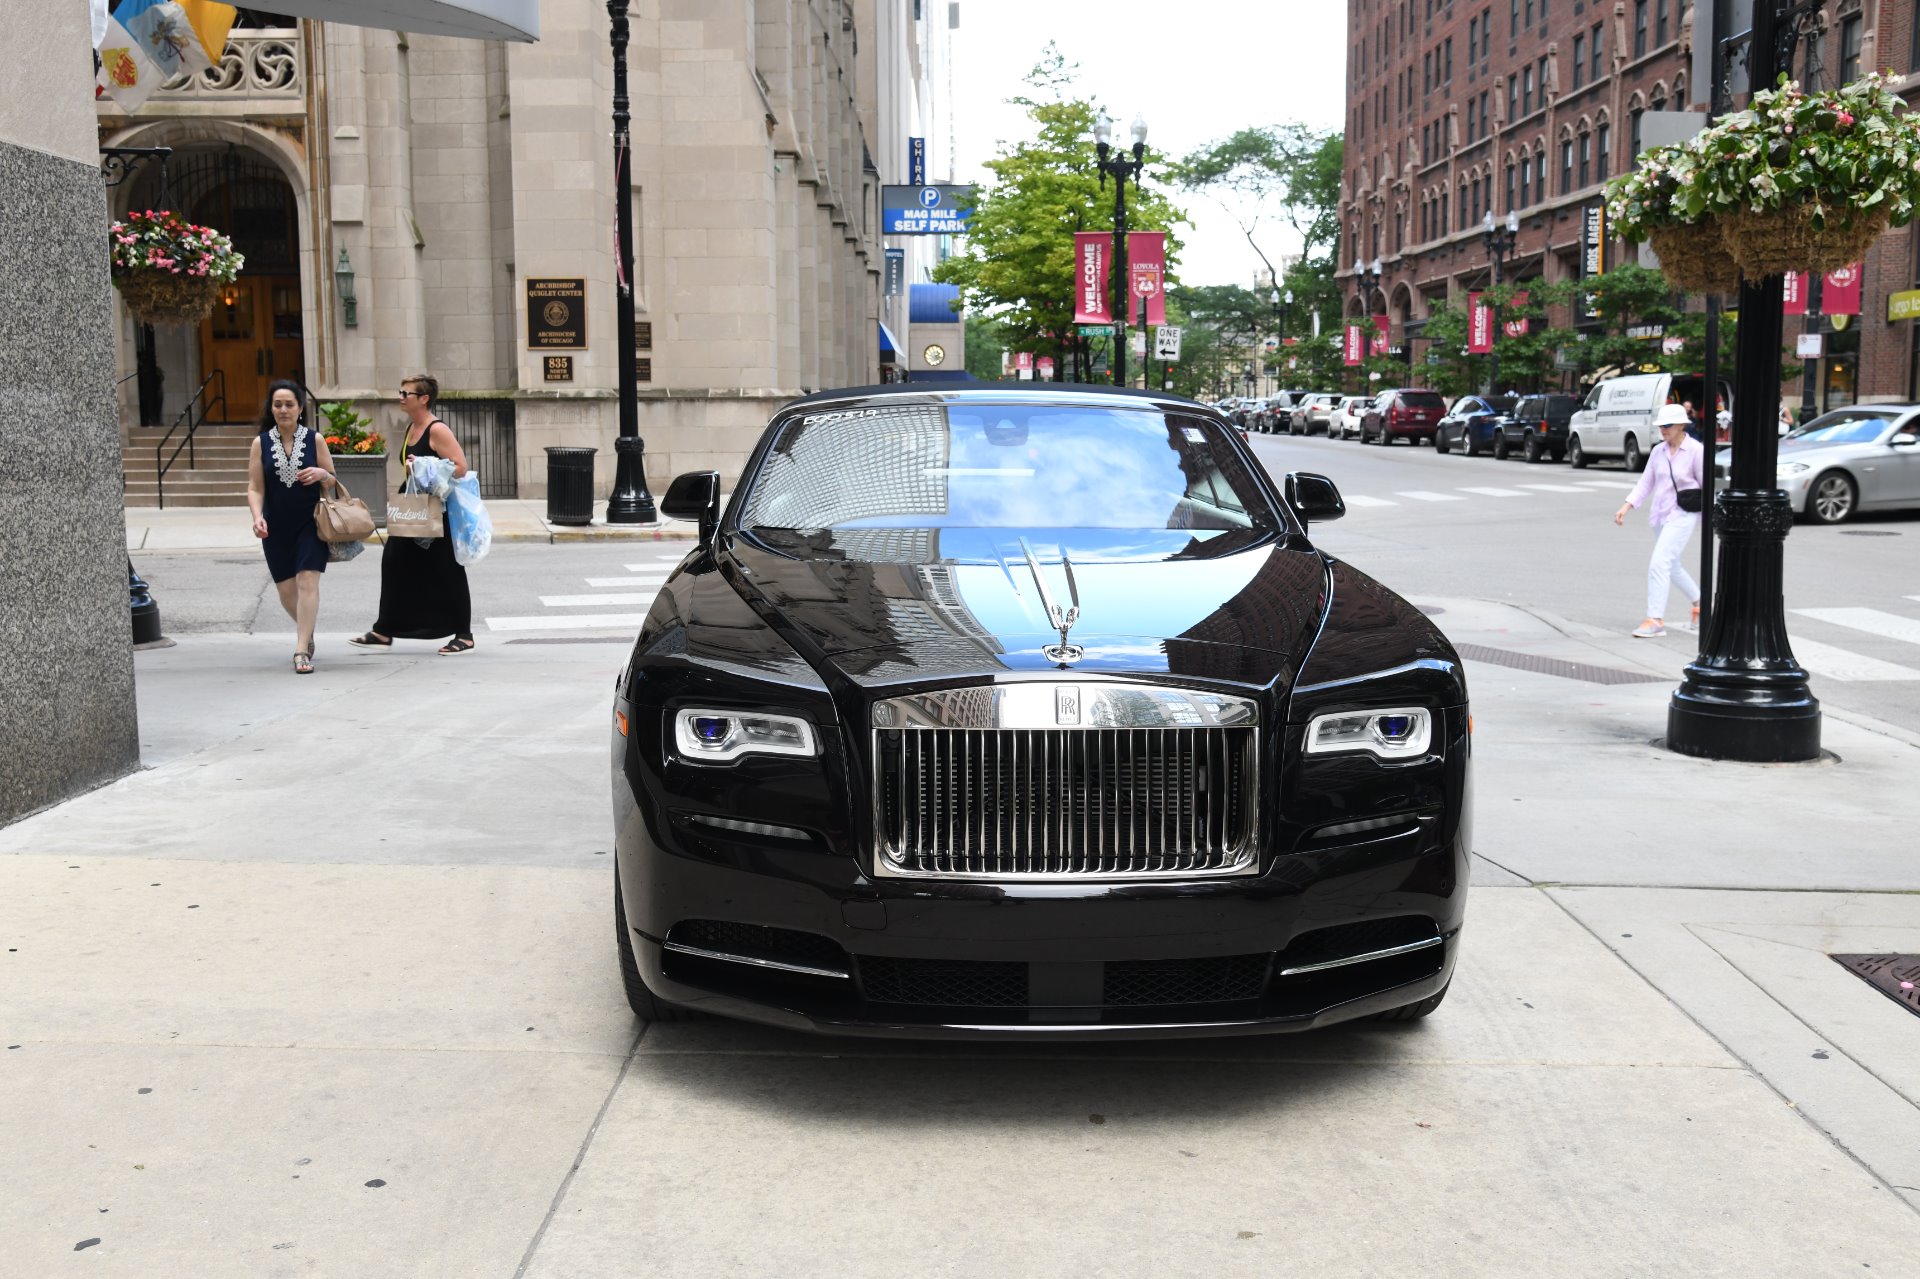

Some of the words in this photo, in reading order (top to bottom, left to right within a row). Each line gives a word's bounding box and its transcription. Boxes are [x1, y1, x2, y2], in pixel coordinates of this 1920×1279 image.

[914, 140, 922, 186] GHIRA
[904, 210, 928, 219] MAG
[930, 210, 957, 219] MILE
[894, 220, 927, 231] SELF
[929, 220, 966, 231] PARK
[1588, 207, 1600, 244] BAGELS
[1084, 243, 1096, 314] WELCOME
[1159, 329, 1178, 338] ONE
[1159, 338, 1178, 347] WAY
[548, 358, 568, 369] 835
